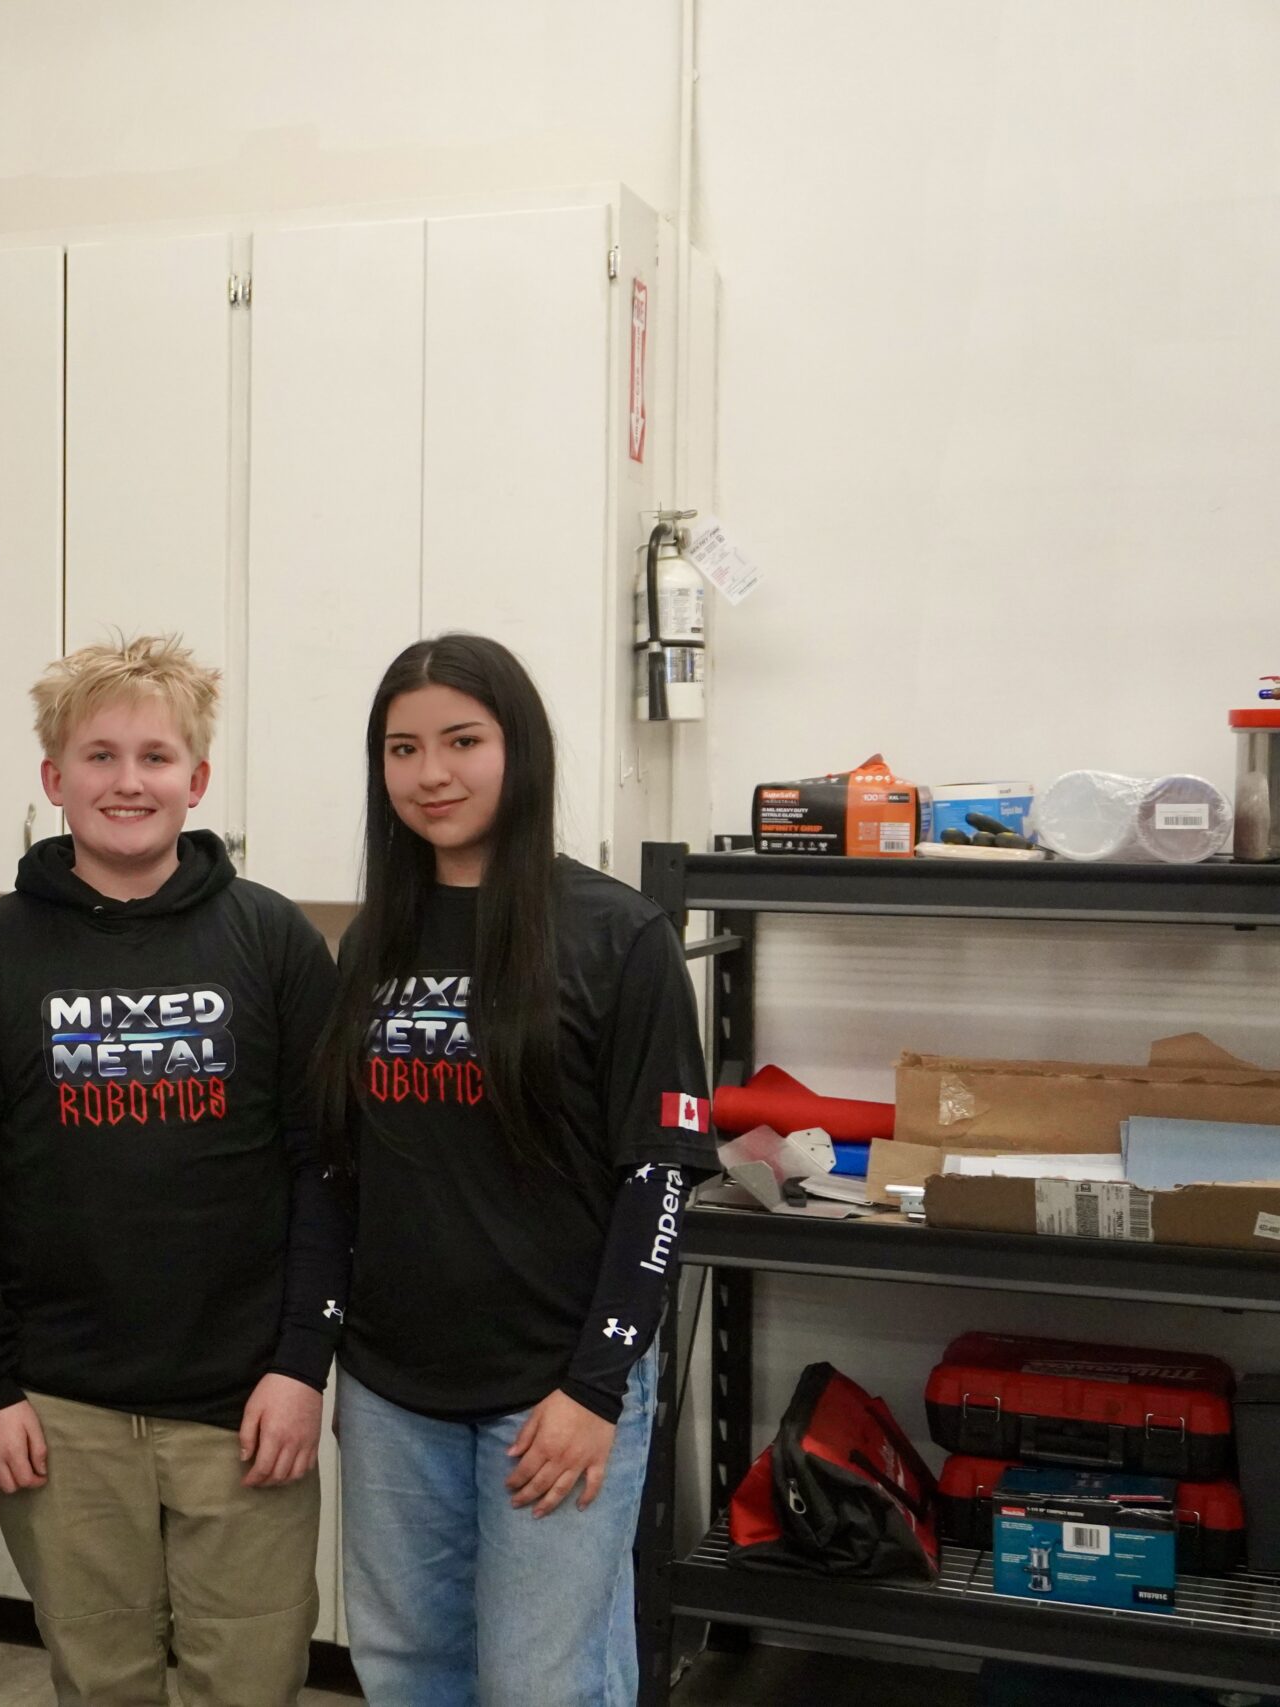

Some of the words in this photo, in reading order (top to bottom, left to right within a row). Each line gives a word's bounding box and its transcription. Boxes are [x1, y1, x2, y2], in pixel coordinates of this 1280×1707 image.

[50, 990, 225, 1030] MIXED
[59, 1076, 227, 1127] ROBOTICS
[370, 1056, 483, 1105] OBOTIC
